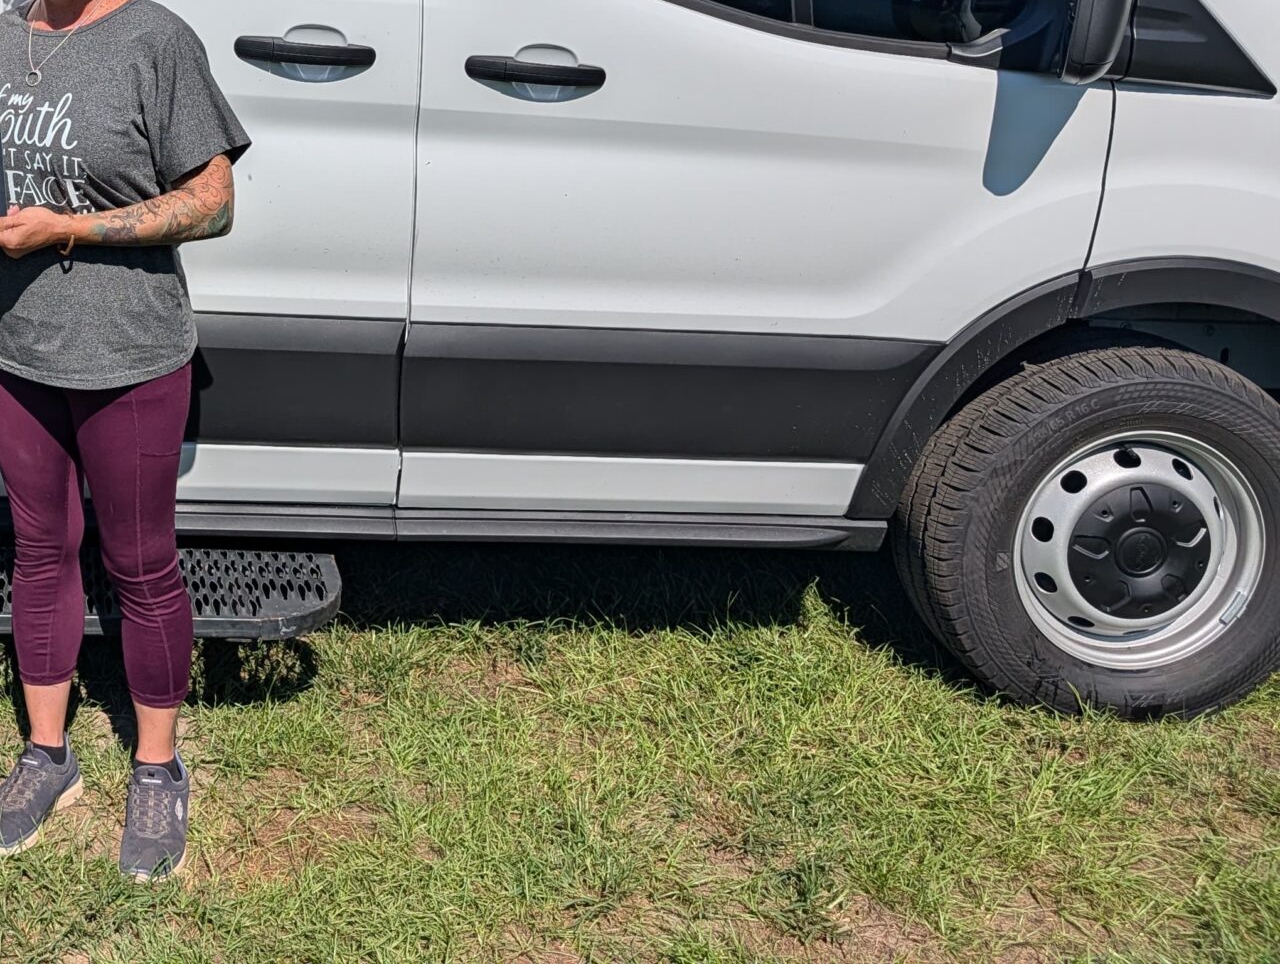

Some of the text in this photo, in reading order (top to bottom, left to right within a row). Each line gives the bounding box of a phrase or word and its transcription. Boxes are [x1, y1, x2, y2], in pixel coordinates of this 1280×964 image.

[8, 93, 34, 113] my
[0, 93, 77, 149] outh
[24, 150, 52, 172] SAY
[5, 170, 90, 208] FACE
